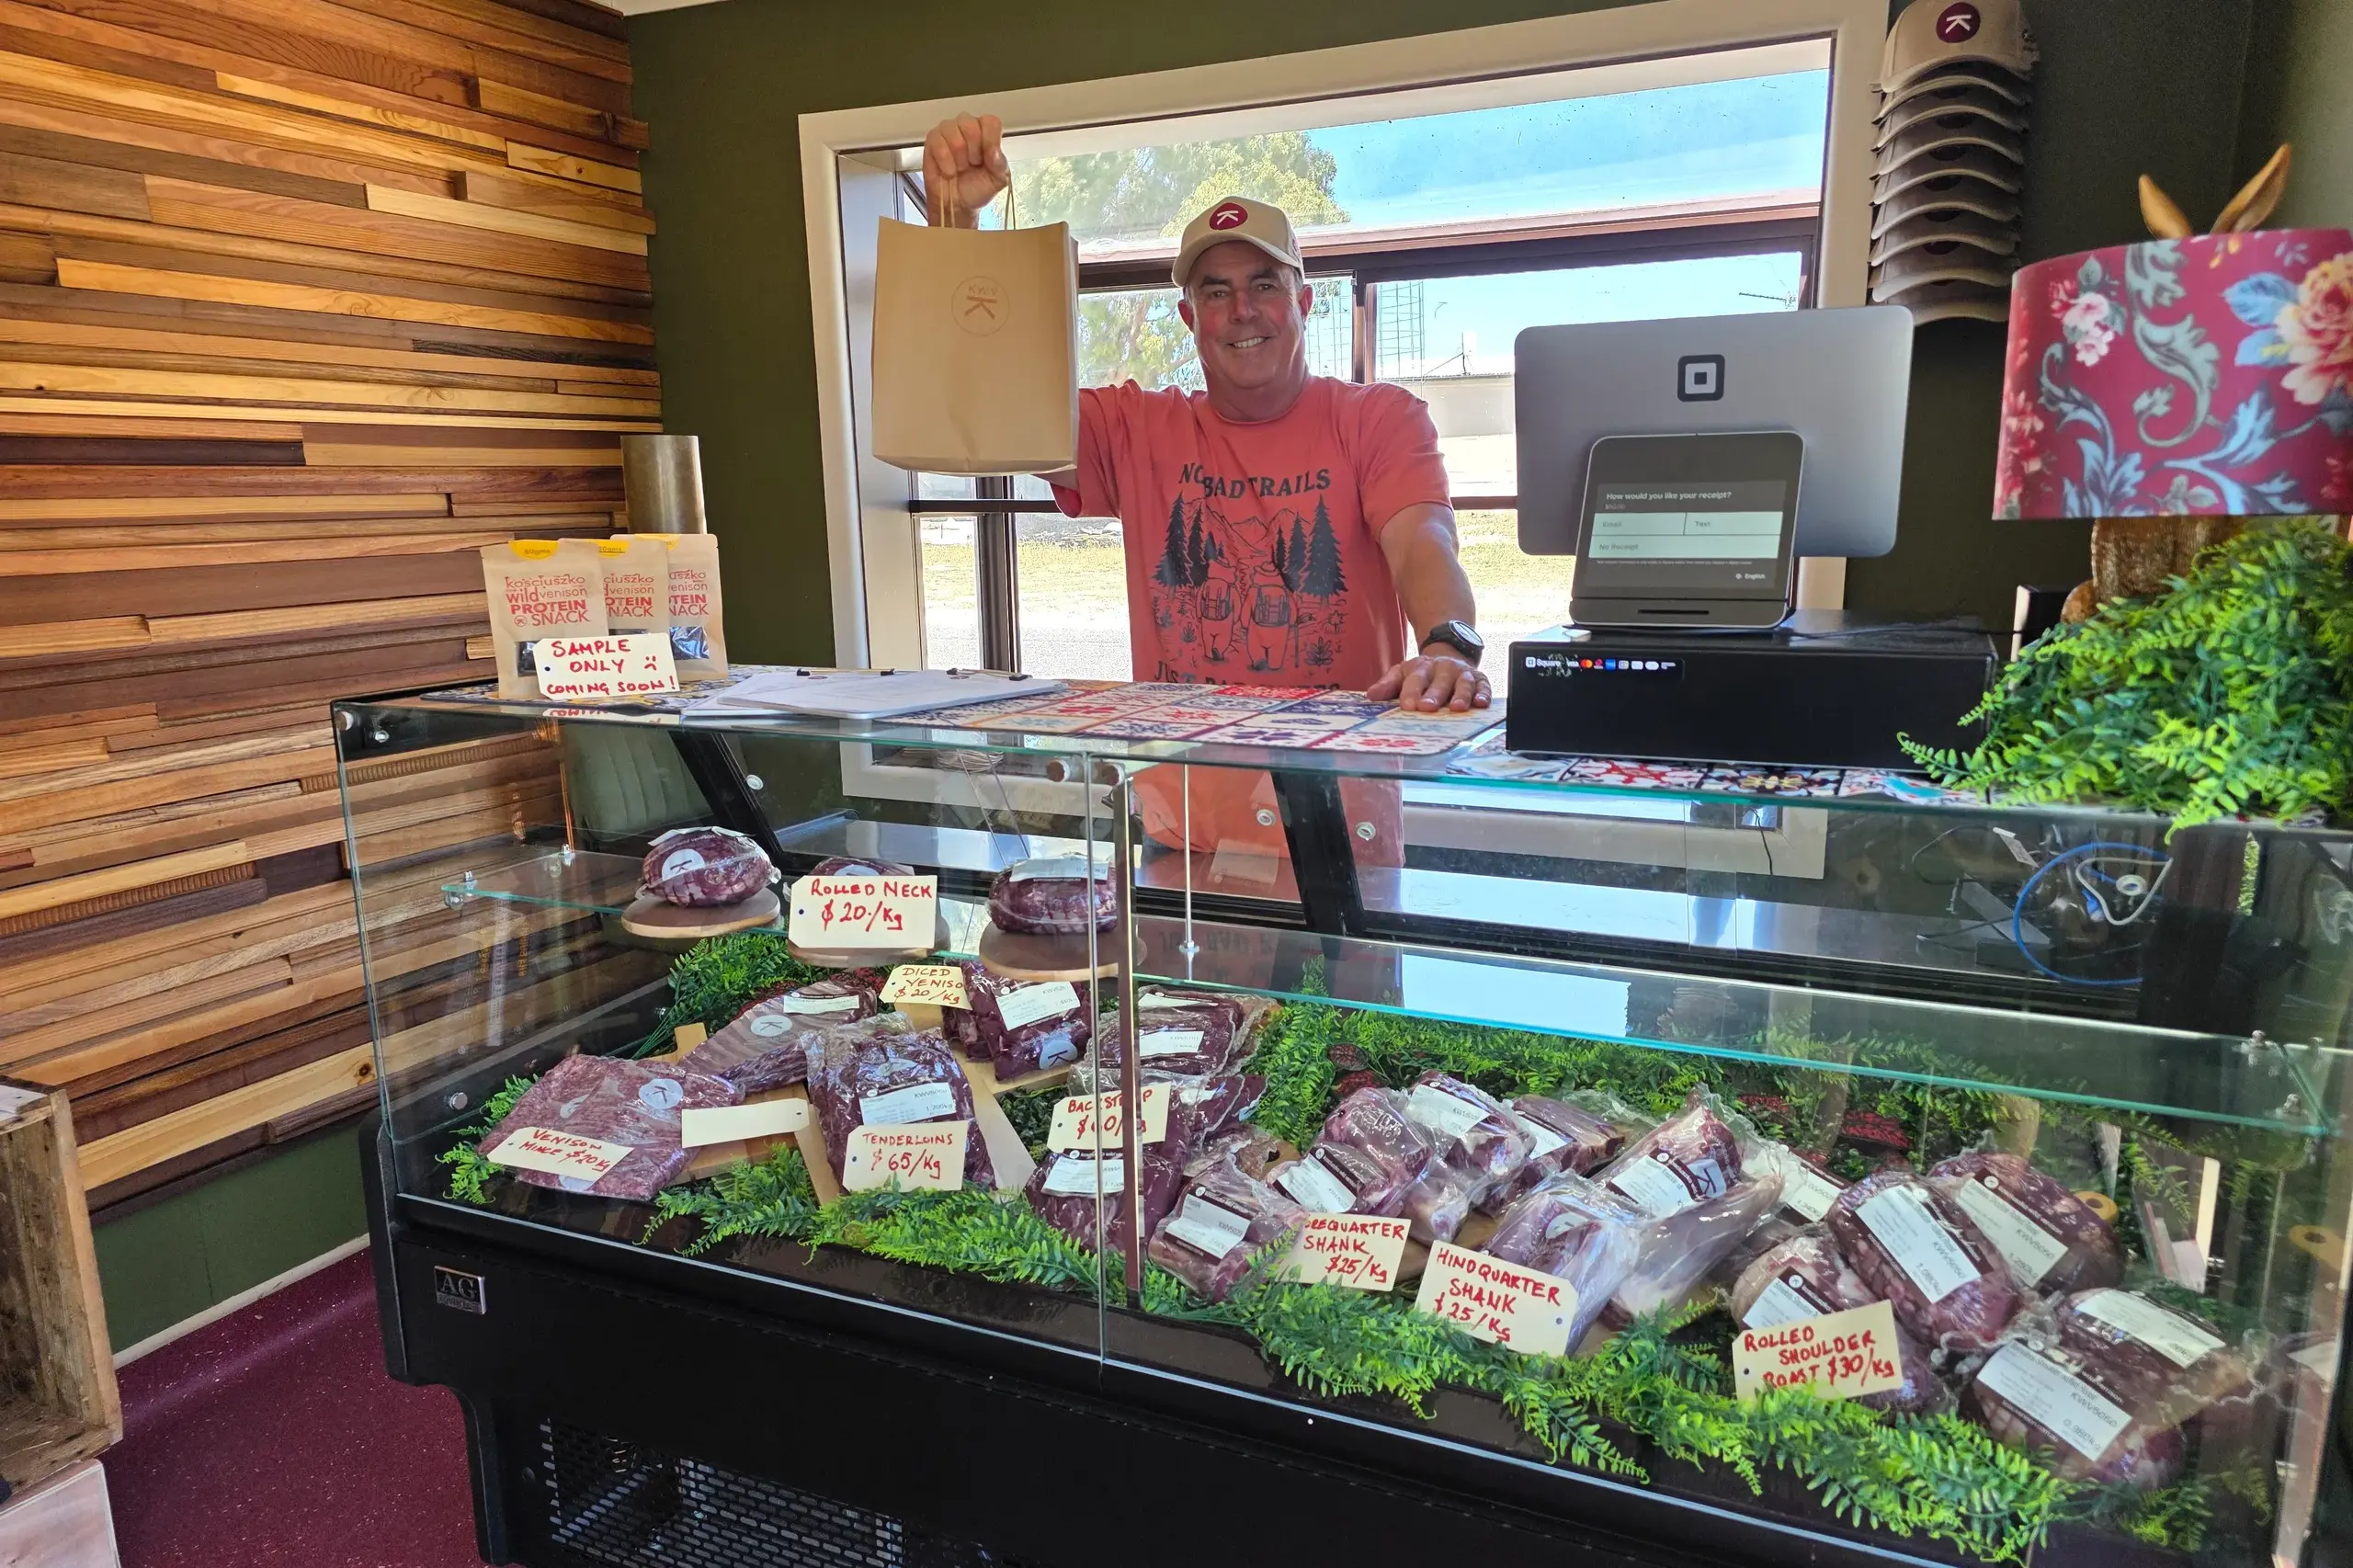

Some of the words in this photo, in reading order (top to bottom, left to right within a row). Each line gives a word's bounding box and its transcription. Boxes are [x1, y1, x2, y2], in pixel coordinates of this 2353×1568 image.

[1203, 476, 1245, 498] BAD
[505, 574, 585, 588] kosciuszko
[604, 574, 654, 583] ciuszko
[669, 570, 706, 579] uszko
[506, 587, 539, 603] wild
[540, 587, 586, 598] venison
[609, 585, 654, 594] venison
[510, 600, 586, 614] PROTEIN
[605, 597, 652, 606] OTEIN
[669, 595, 706, 604] TEIN
[607, 607, 654, 617] NACK
[669, 604, 709, 616] NACK
[532, 610, 590, 626] SNACK
[551, 639, 631, 657] SAMPLE
[570, 659, 624, 674] ONLY
[547, 683, 609, 695] COMING
[811, 879, 875, 896] ROLLED
[884, 881, 932, 899] NECK
[903, 968, 950, 976] DICED
[1068, 1089, 1153, 1113] BACSTP
[532, 1130, 602, 1150] VENISON
[862, 1133, 952, 1145] TENDERLOINS
[519, 1142, 563, 1155] MINCE
[1304, 1235, 1370, 1255] SHANK
[1437, 1248, 1561, 1307] HINDQUARTER
[1449, 1278, 1517, 1314] SHANK
[1744, 1326, 1814, 1352] ROLLED
[1779, 1330, 1875, 1365] SHOULDER
[1763, 1364, 1820, 1388] ROAST
